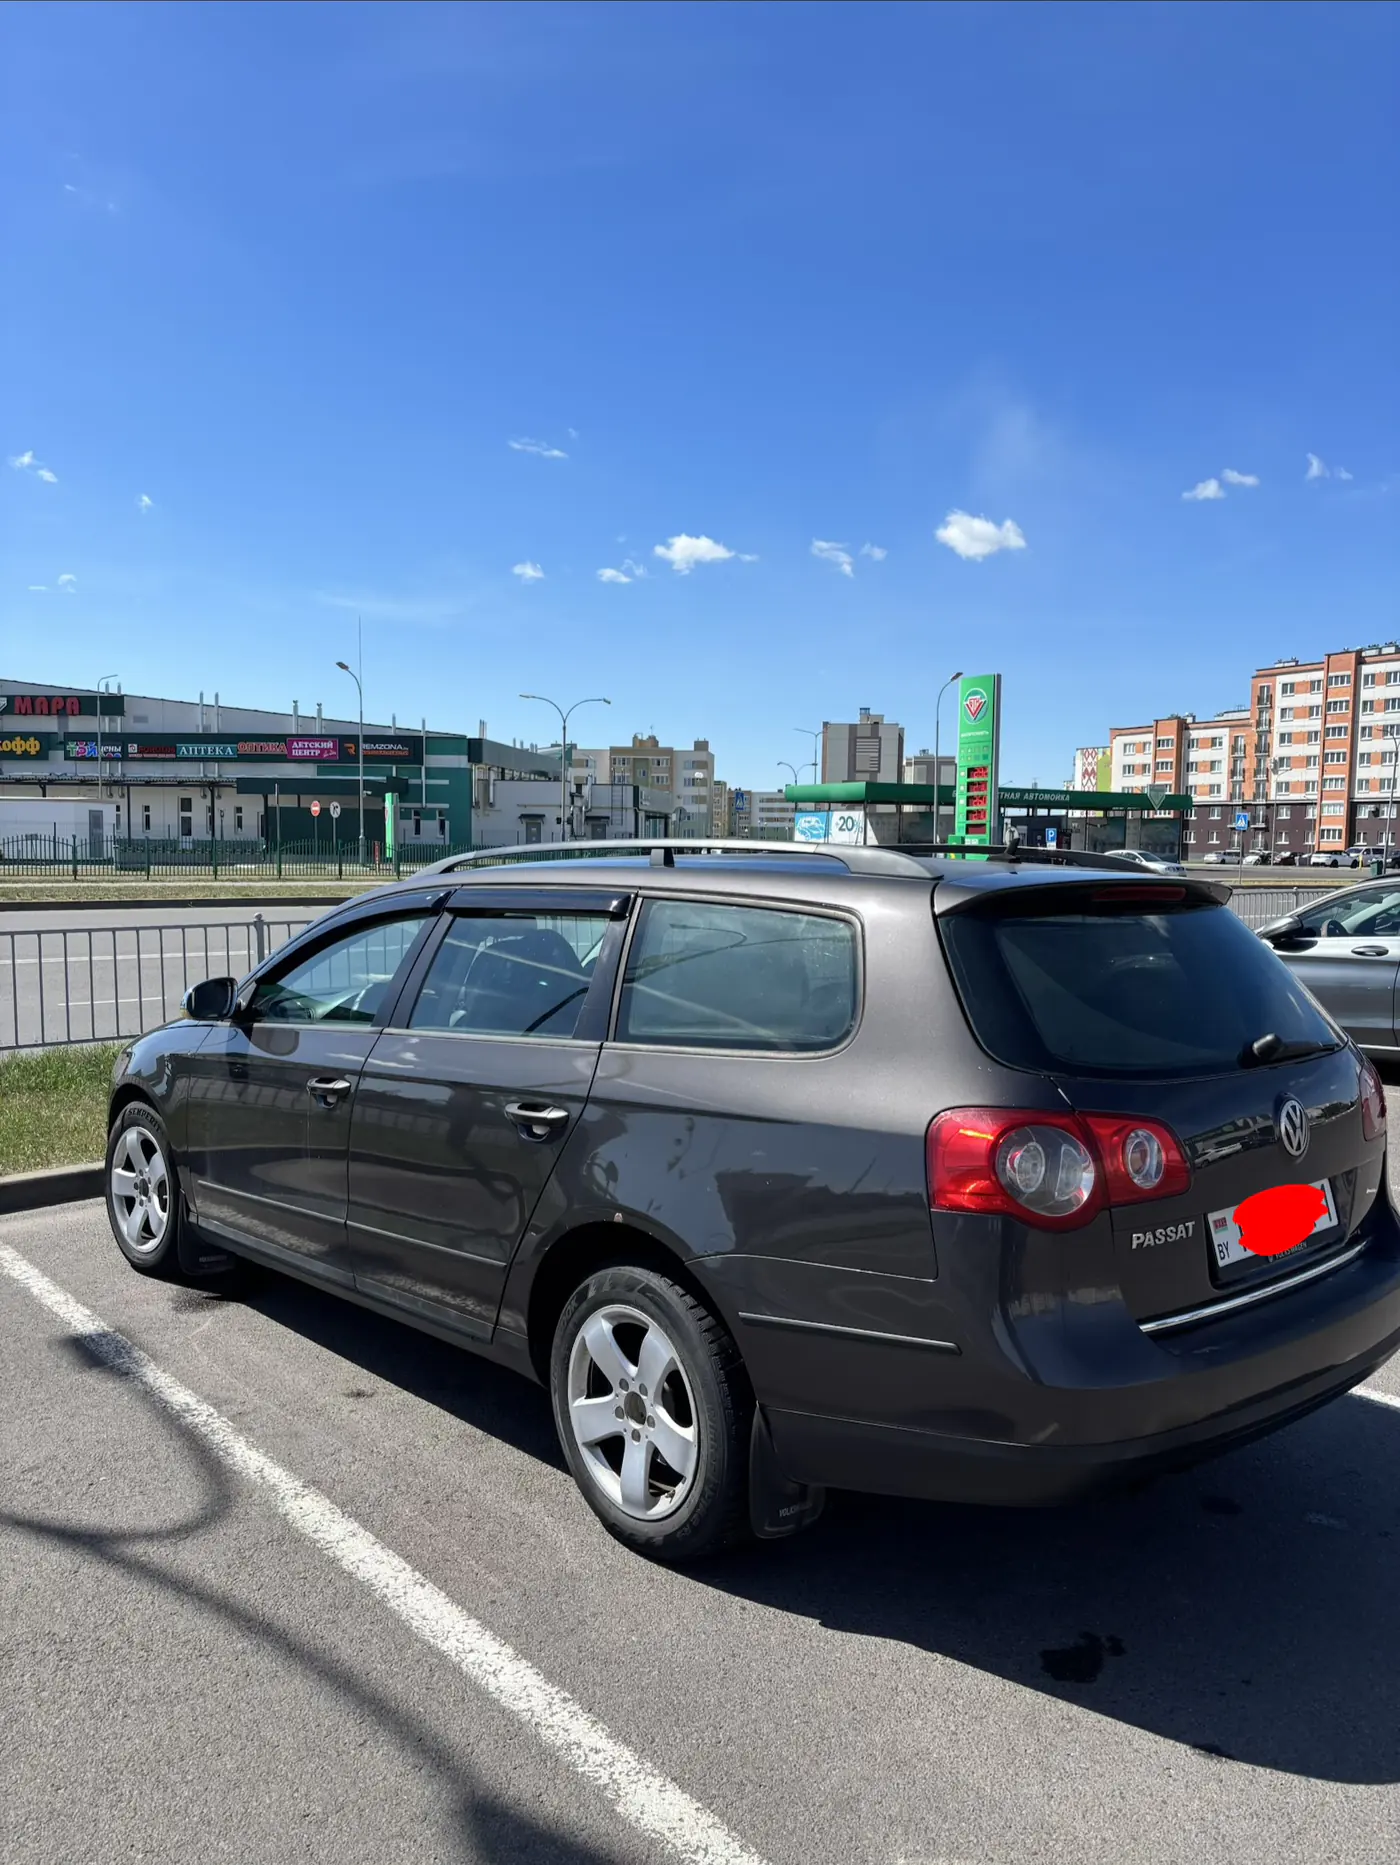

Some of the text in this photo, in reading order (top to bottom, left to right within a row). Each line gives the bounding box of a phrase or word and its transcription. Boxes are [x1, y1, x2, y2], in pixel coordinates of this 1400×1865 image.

[237, 742, 287, 753] ОПТИКА
[291, 740, 334, 749] ДЕТСКИЙ
[180, 746, 234, 755] АПТЕКА
[1023, 791, 1070, 801] АВТОМОЙКА
[1131, 1221, 1196, 1250] PASSAT
[1217, 1241, 1230, 1261] BY
